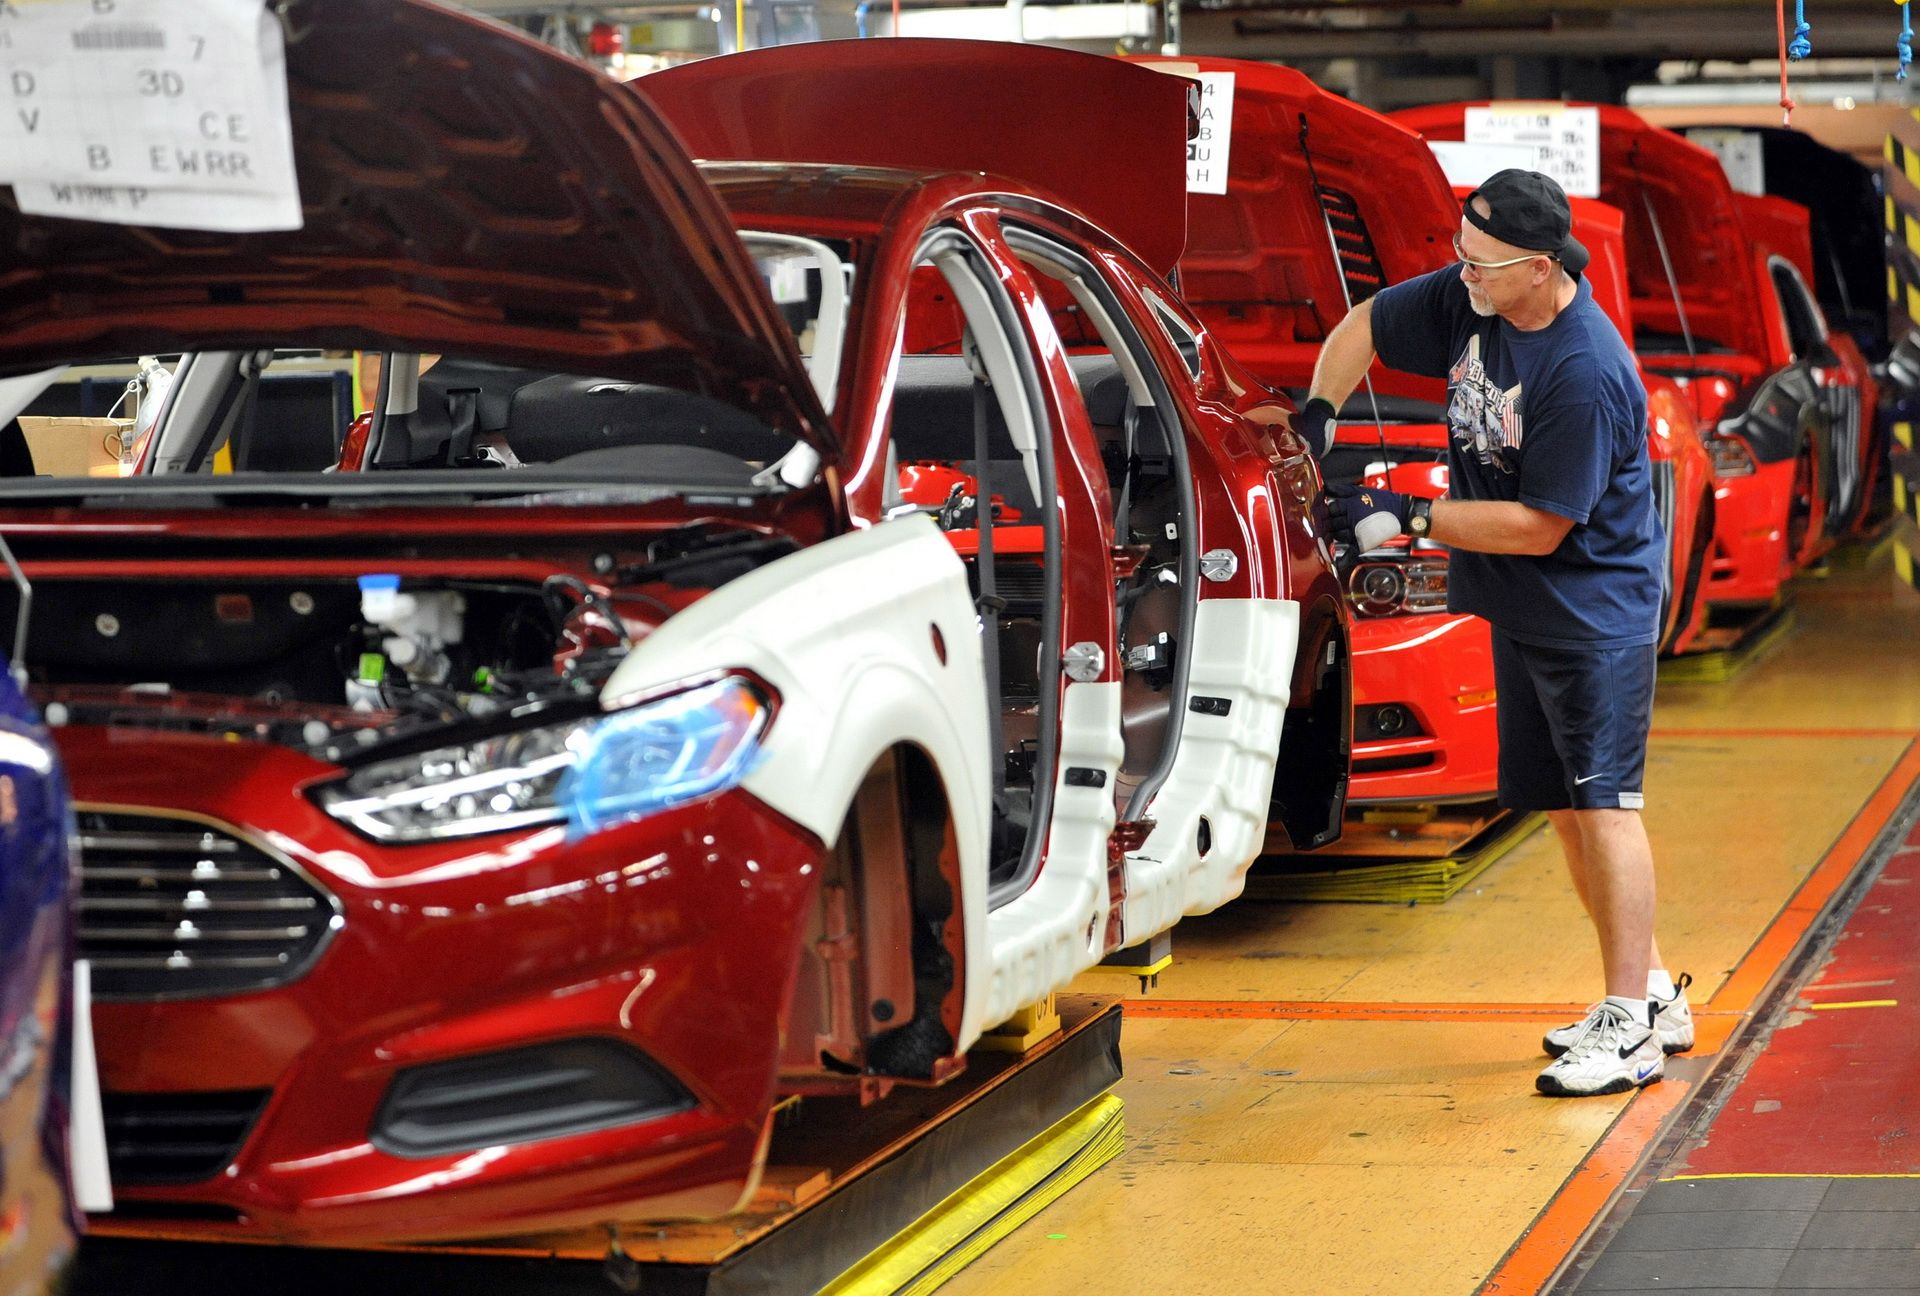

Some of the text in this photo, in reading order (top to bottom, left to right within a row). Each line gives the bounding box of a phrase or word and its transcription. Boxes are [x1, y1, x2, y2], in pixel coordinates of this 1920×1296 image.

[188, 35, 205, 61] 7
[11, 69, 184, 98] D 3D
[1203, 83, 1215, 96] 4
[1201, 107, 1214, 120] A
[18, 108, 40, 134] V
[1200, 127, 1212, 140] B
[86, 145, 111, 172] B
[1198, 148, 1211, 161] U
[1196, 169, 1209, 182] H
